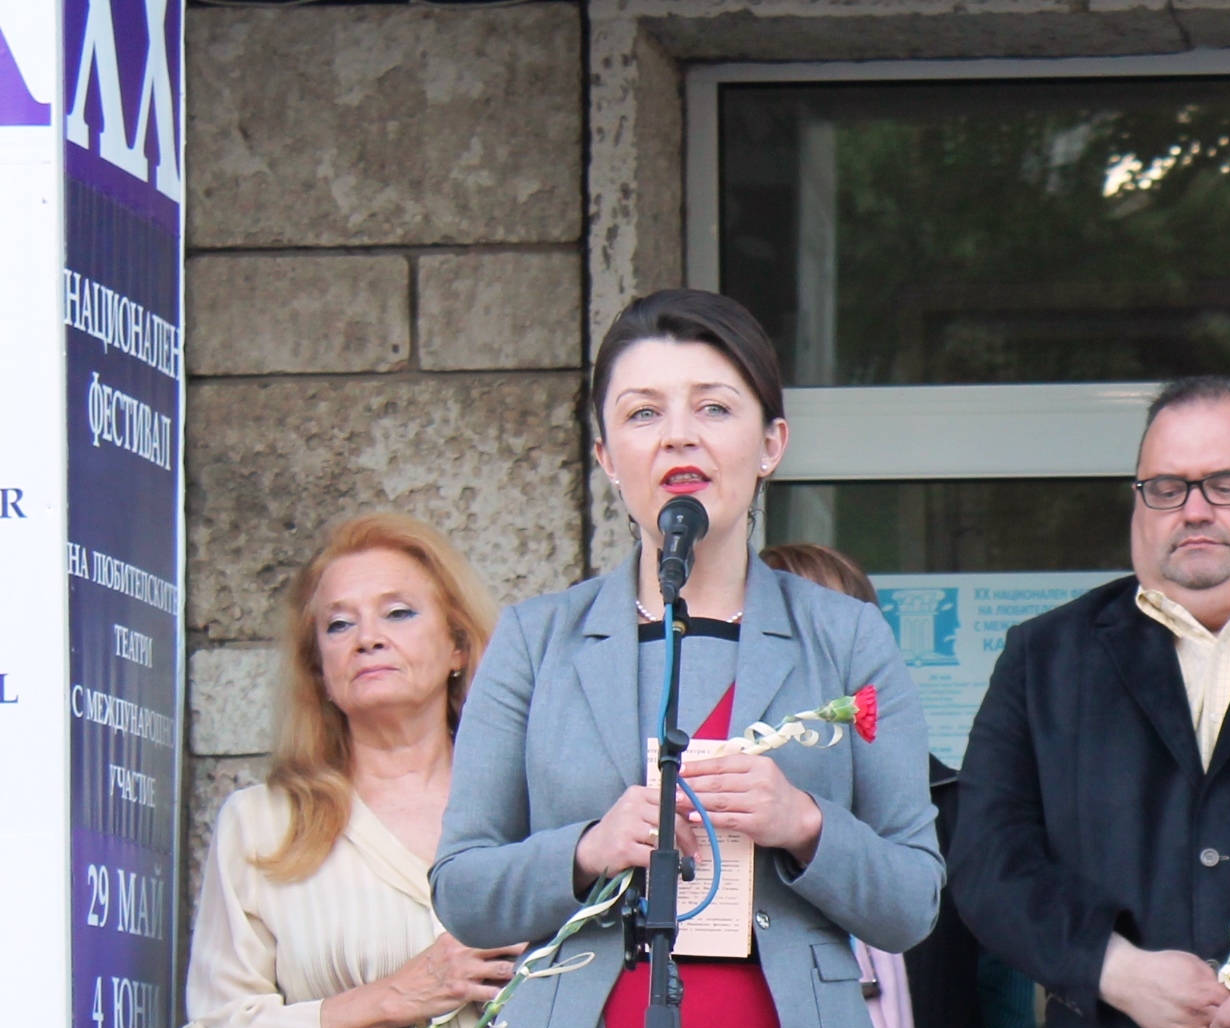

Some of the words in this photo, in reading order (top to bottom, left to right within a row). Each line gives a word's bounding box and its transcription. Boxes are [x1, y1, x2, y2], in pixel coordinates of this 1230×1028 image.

[64, 269, 181, 381] НАЦИОНАЛЕН
[88, 372, 171, 471] ФЕСТИВАЛ
[68, 541, 89, 580] НА
[114, 624, 153, 668] ТЕАТРИ
[72, 684, 84, 718] С
[110, 765, 155, 808] УЧАСТИЕ
[87, 864, 109, 927] 29
[117, 864, 163, 940] МАЙ
